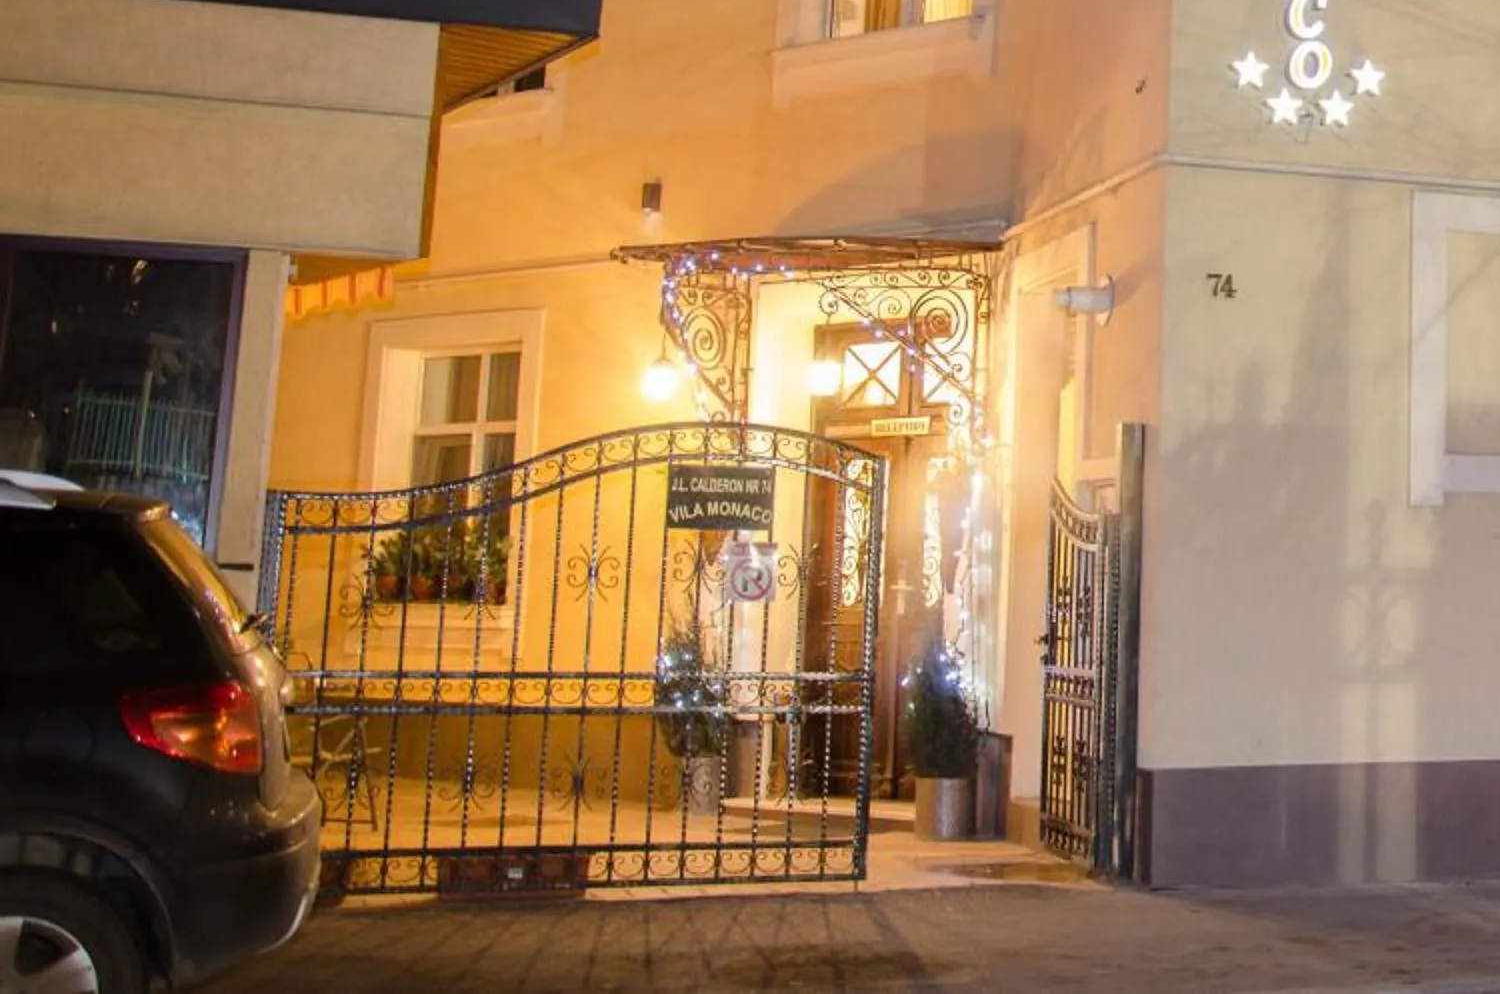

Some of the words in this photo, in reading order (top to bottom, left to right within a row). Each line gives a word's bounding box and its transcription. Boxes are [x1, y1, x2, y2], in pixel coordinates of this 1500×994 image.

[1206, 273, 1237, 299] 74
[690, 477, 744, 493] CALDERON
[745, 478, 759, 494] NR
[669, 502, 705, 523] VILA
[706, 501, 772, 523] MONACO
